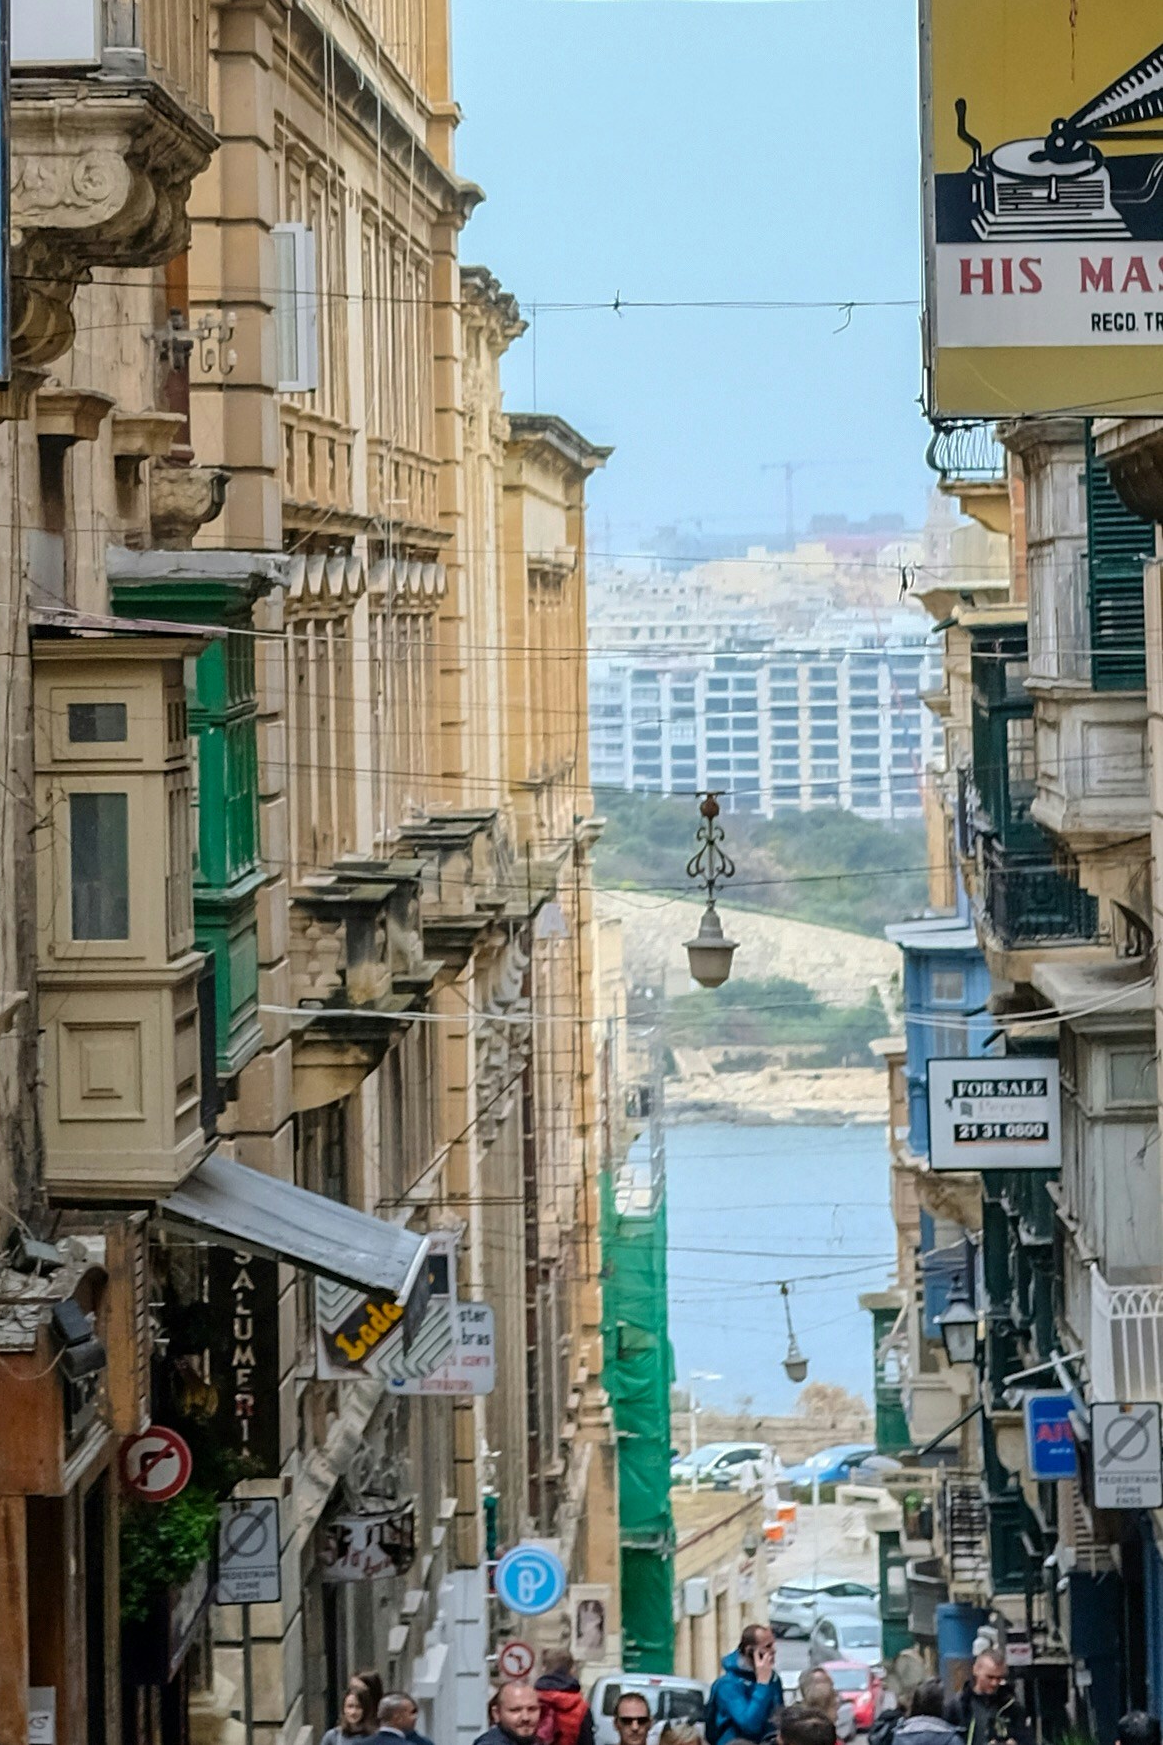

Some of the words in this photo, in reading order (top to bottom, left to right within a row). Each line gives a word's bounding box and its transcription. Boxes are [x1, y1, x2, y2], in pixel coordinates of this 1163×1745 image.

[959, 257, 1043, 295] HIS
[1079, 256, 1163, 294] MA
[1091, 312, 1138, 332] REGD.
[957, 1081, 994, 1096] FOR
[997, 1080, 1045, 1095] SALE
[959, 1125, 978, 1138] 21
[982, 1124, 1001, 1138] 31
[1005, 1123, 1045, 1137] 0800
